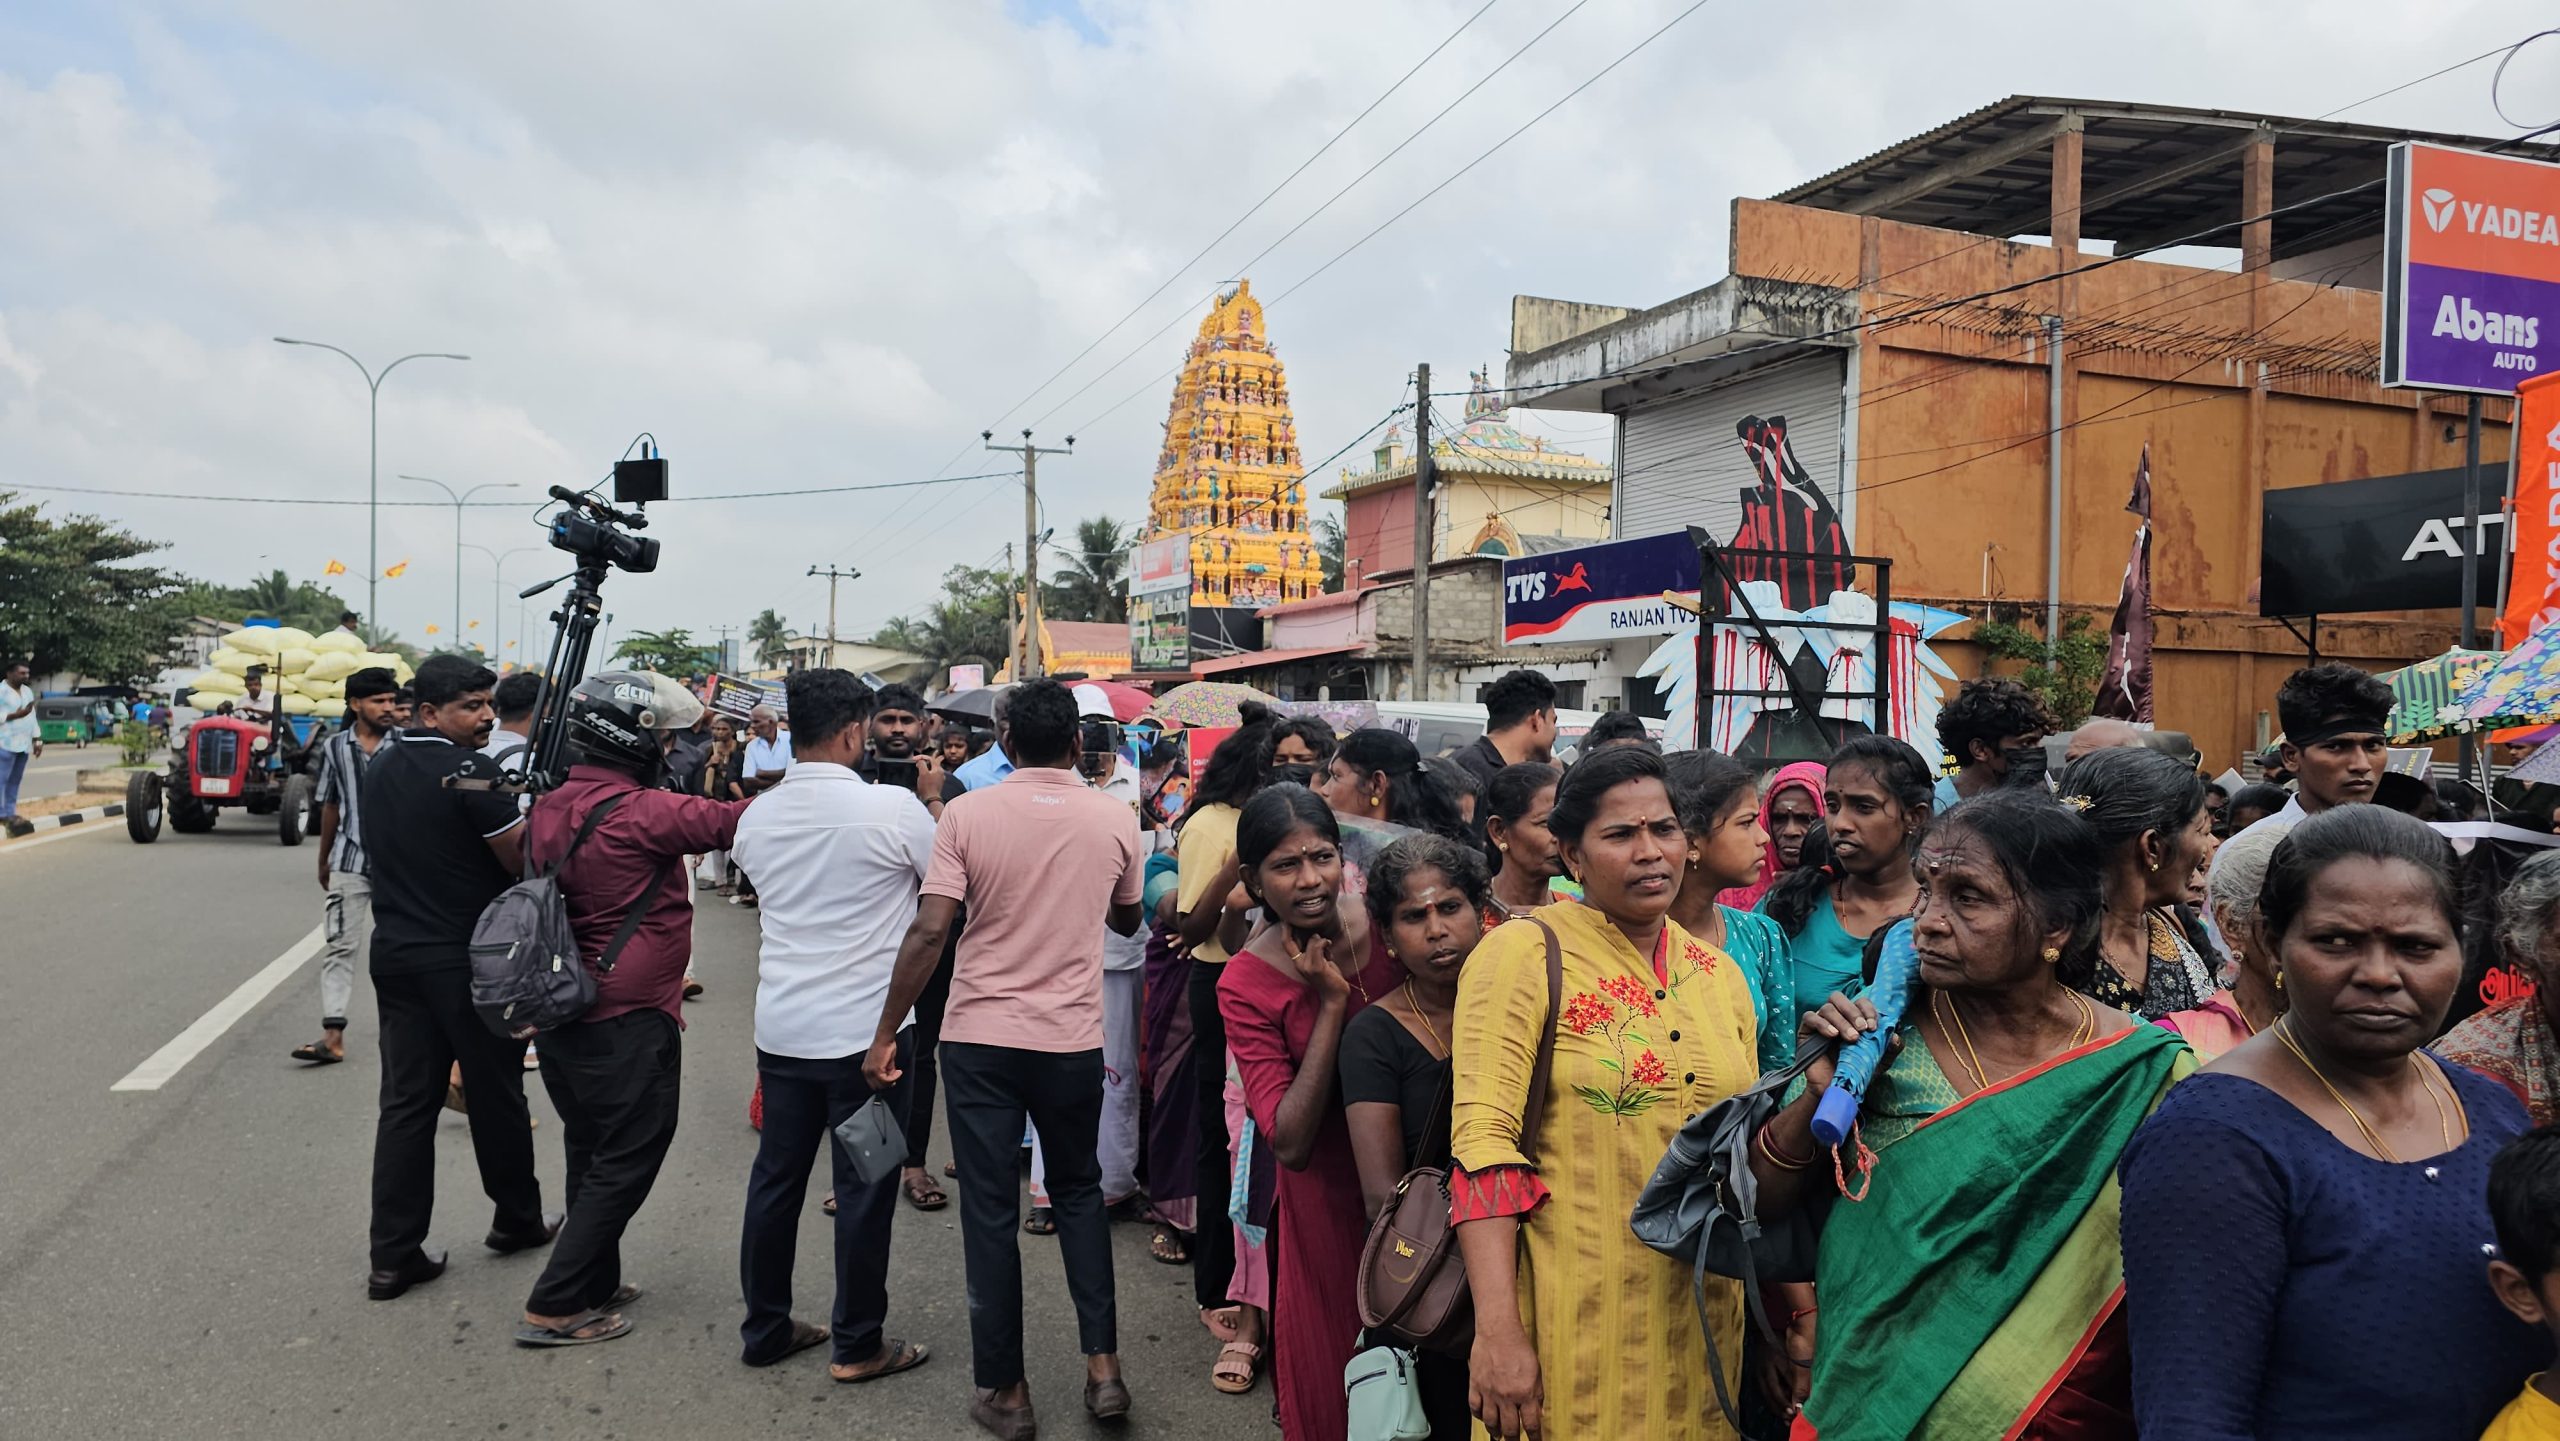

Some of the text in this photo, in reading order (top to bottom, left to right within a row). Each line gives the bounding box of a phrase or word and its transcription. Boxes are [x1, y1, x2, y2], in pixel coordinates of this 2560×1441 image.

[2461, 200, 2560, 246] YADEA
[2432, 294, 2539, 349] Abans
[2493, 351, 2536, 372] AUTO
[1507, 571, 1546, 603] TVS
[1611, 607, 1664, 629] RANJAN
